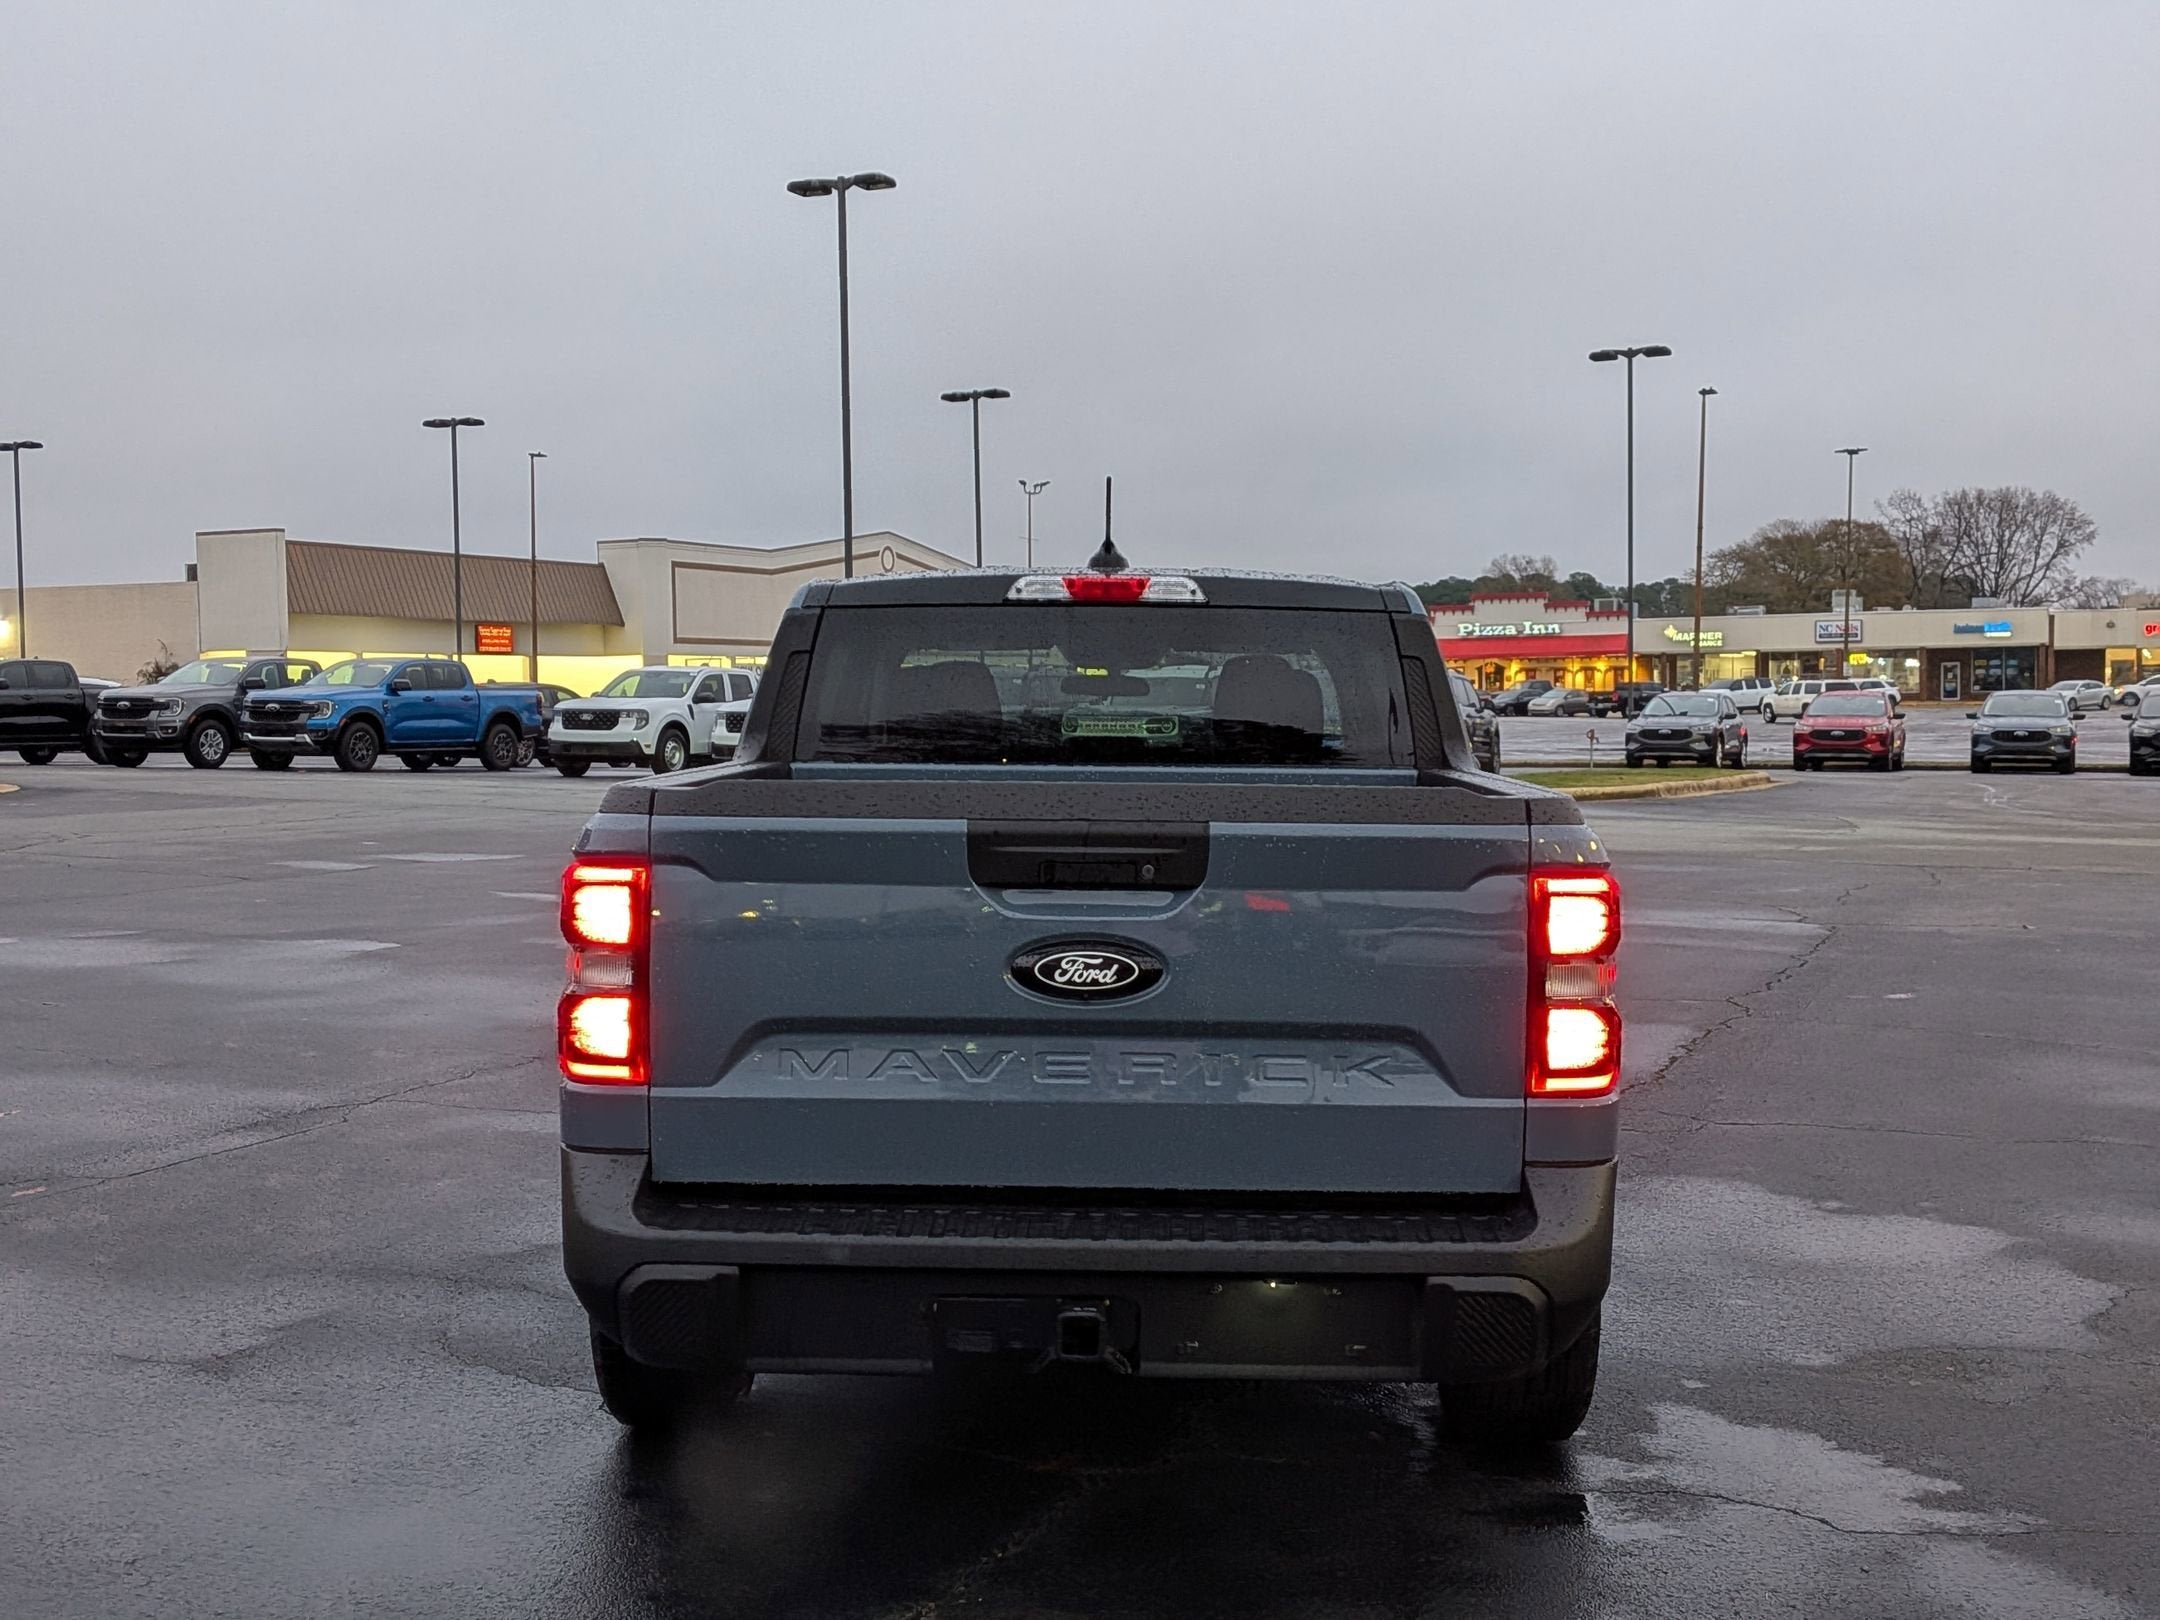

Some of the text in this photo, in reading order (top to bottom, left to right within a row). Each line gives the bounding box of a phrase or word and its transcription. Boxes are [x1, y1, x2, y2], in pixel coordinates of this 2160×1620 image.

[1457, 621, 1561, 636] Pizza Inn
[1819, 624, 1833, 633] NC
[2145, 625, 2160, 635] gr
[1672, 631, 1723, 641] MARNER
[1053, 956, 1119, 984] Ford
[778, 1048, 1396, 1088] MAVERICK
